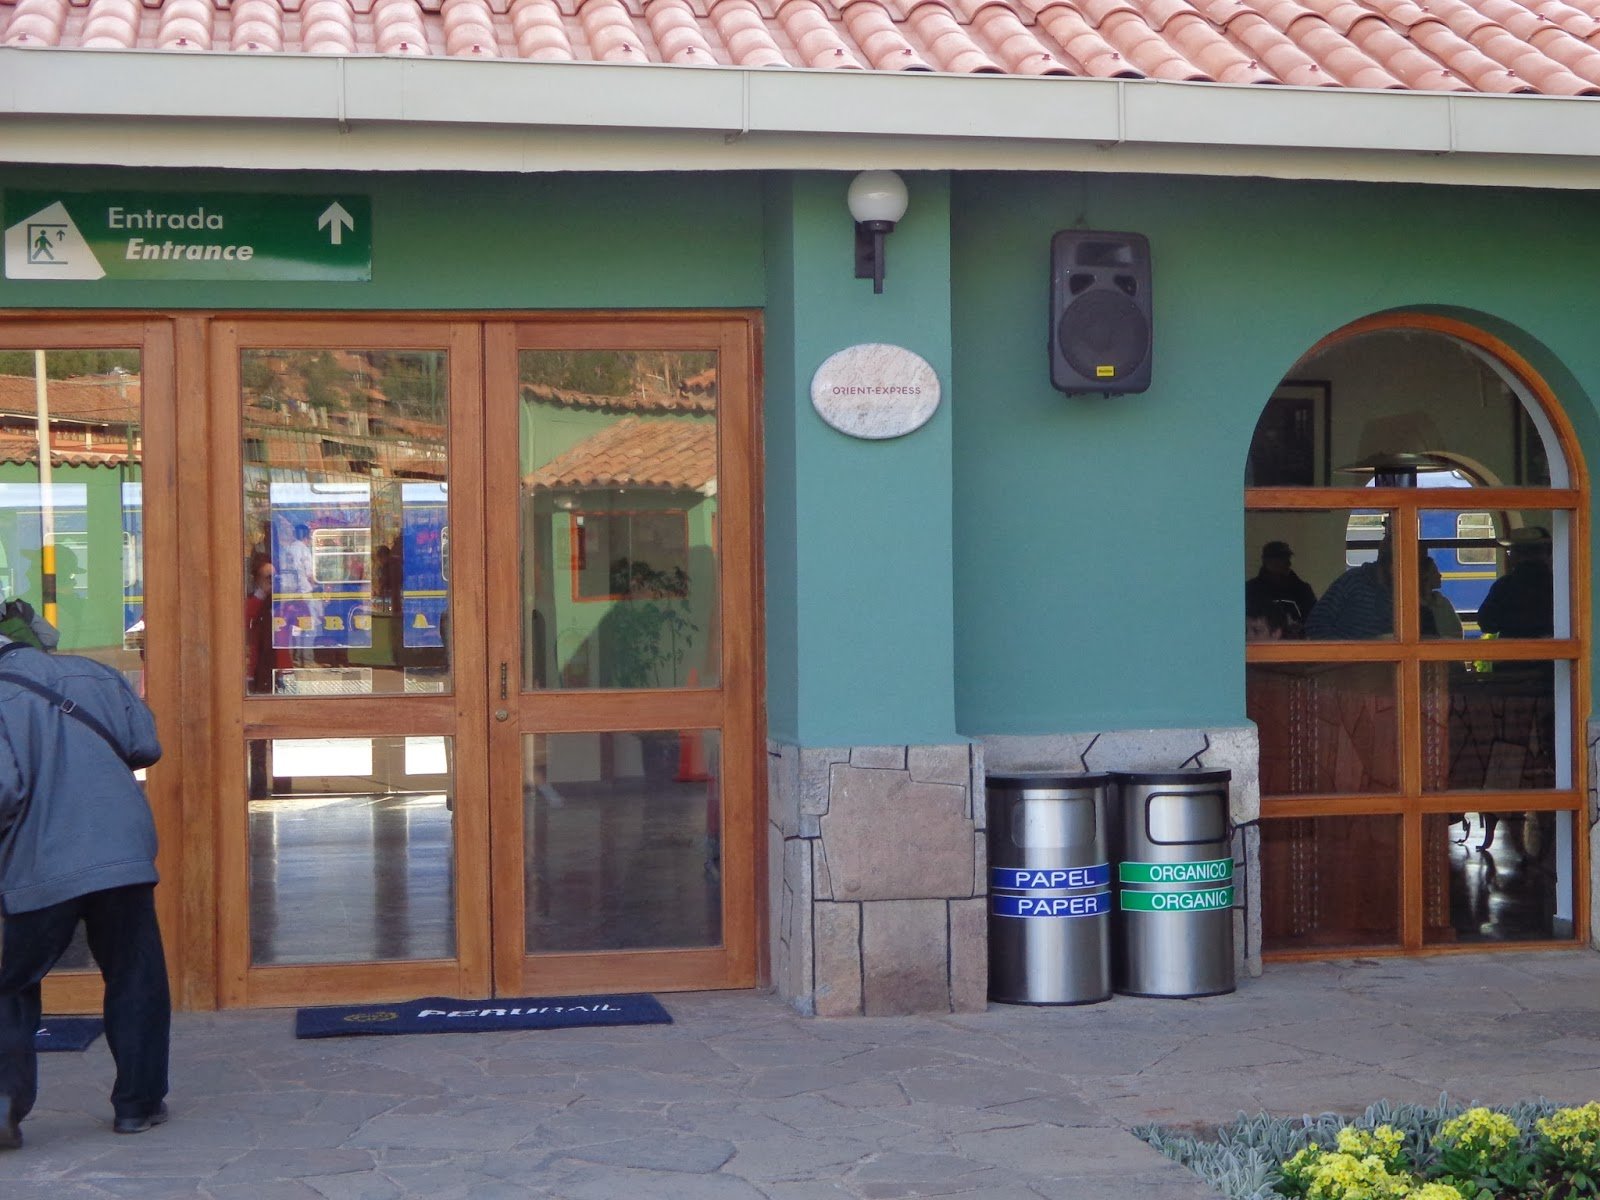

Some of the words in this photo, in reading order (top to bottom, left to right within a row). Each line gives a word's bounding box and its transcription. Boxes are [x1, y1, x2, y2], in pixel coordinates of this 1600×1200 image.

[108, 207, 224, 230] Entrada
[125, 238, 254, 261] Entrance
[832, 386, 921, 395] ORIENT-EXPRESS
[1015, 870, 1095, 887] PAPEL
[1150, 862, 1226, 881] ORGANICO
[1018, 897, 1097, 915] PAPER
[1151, 890, 1227, 909] ORGANIC
